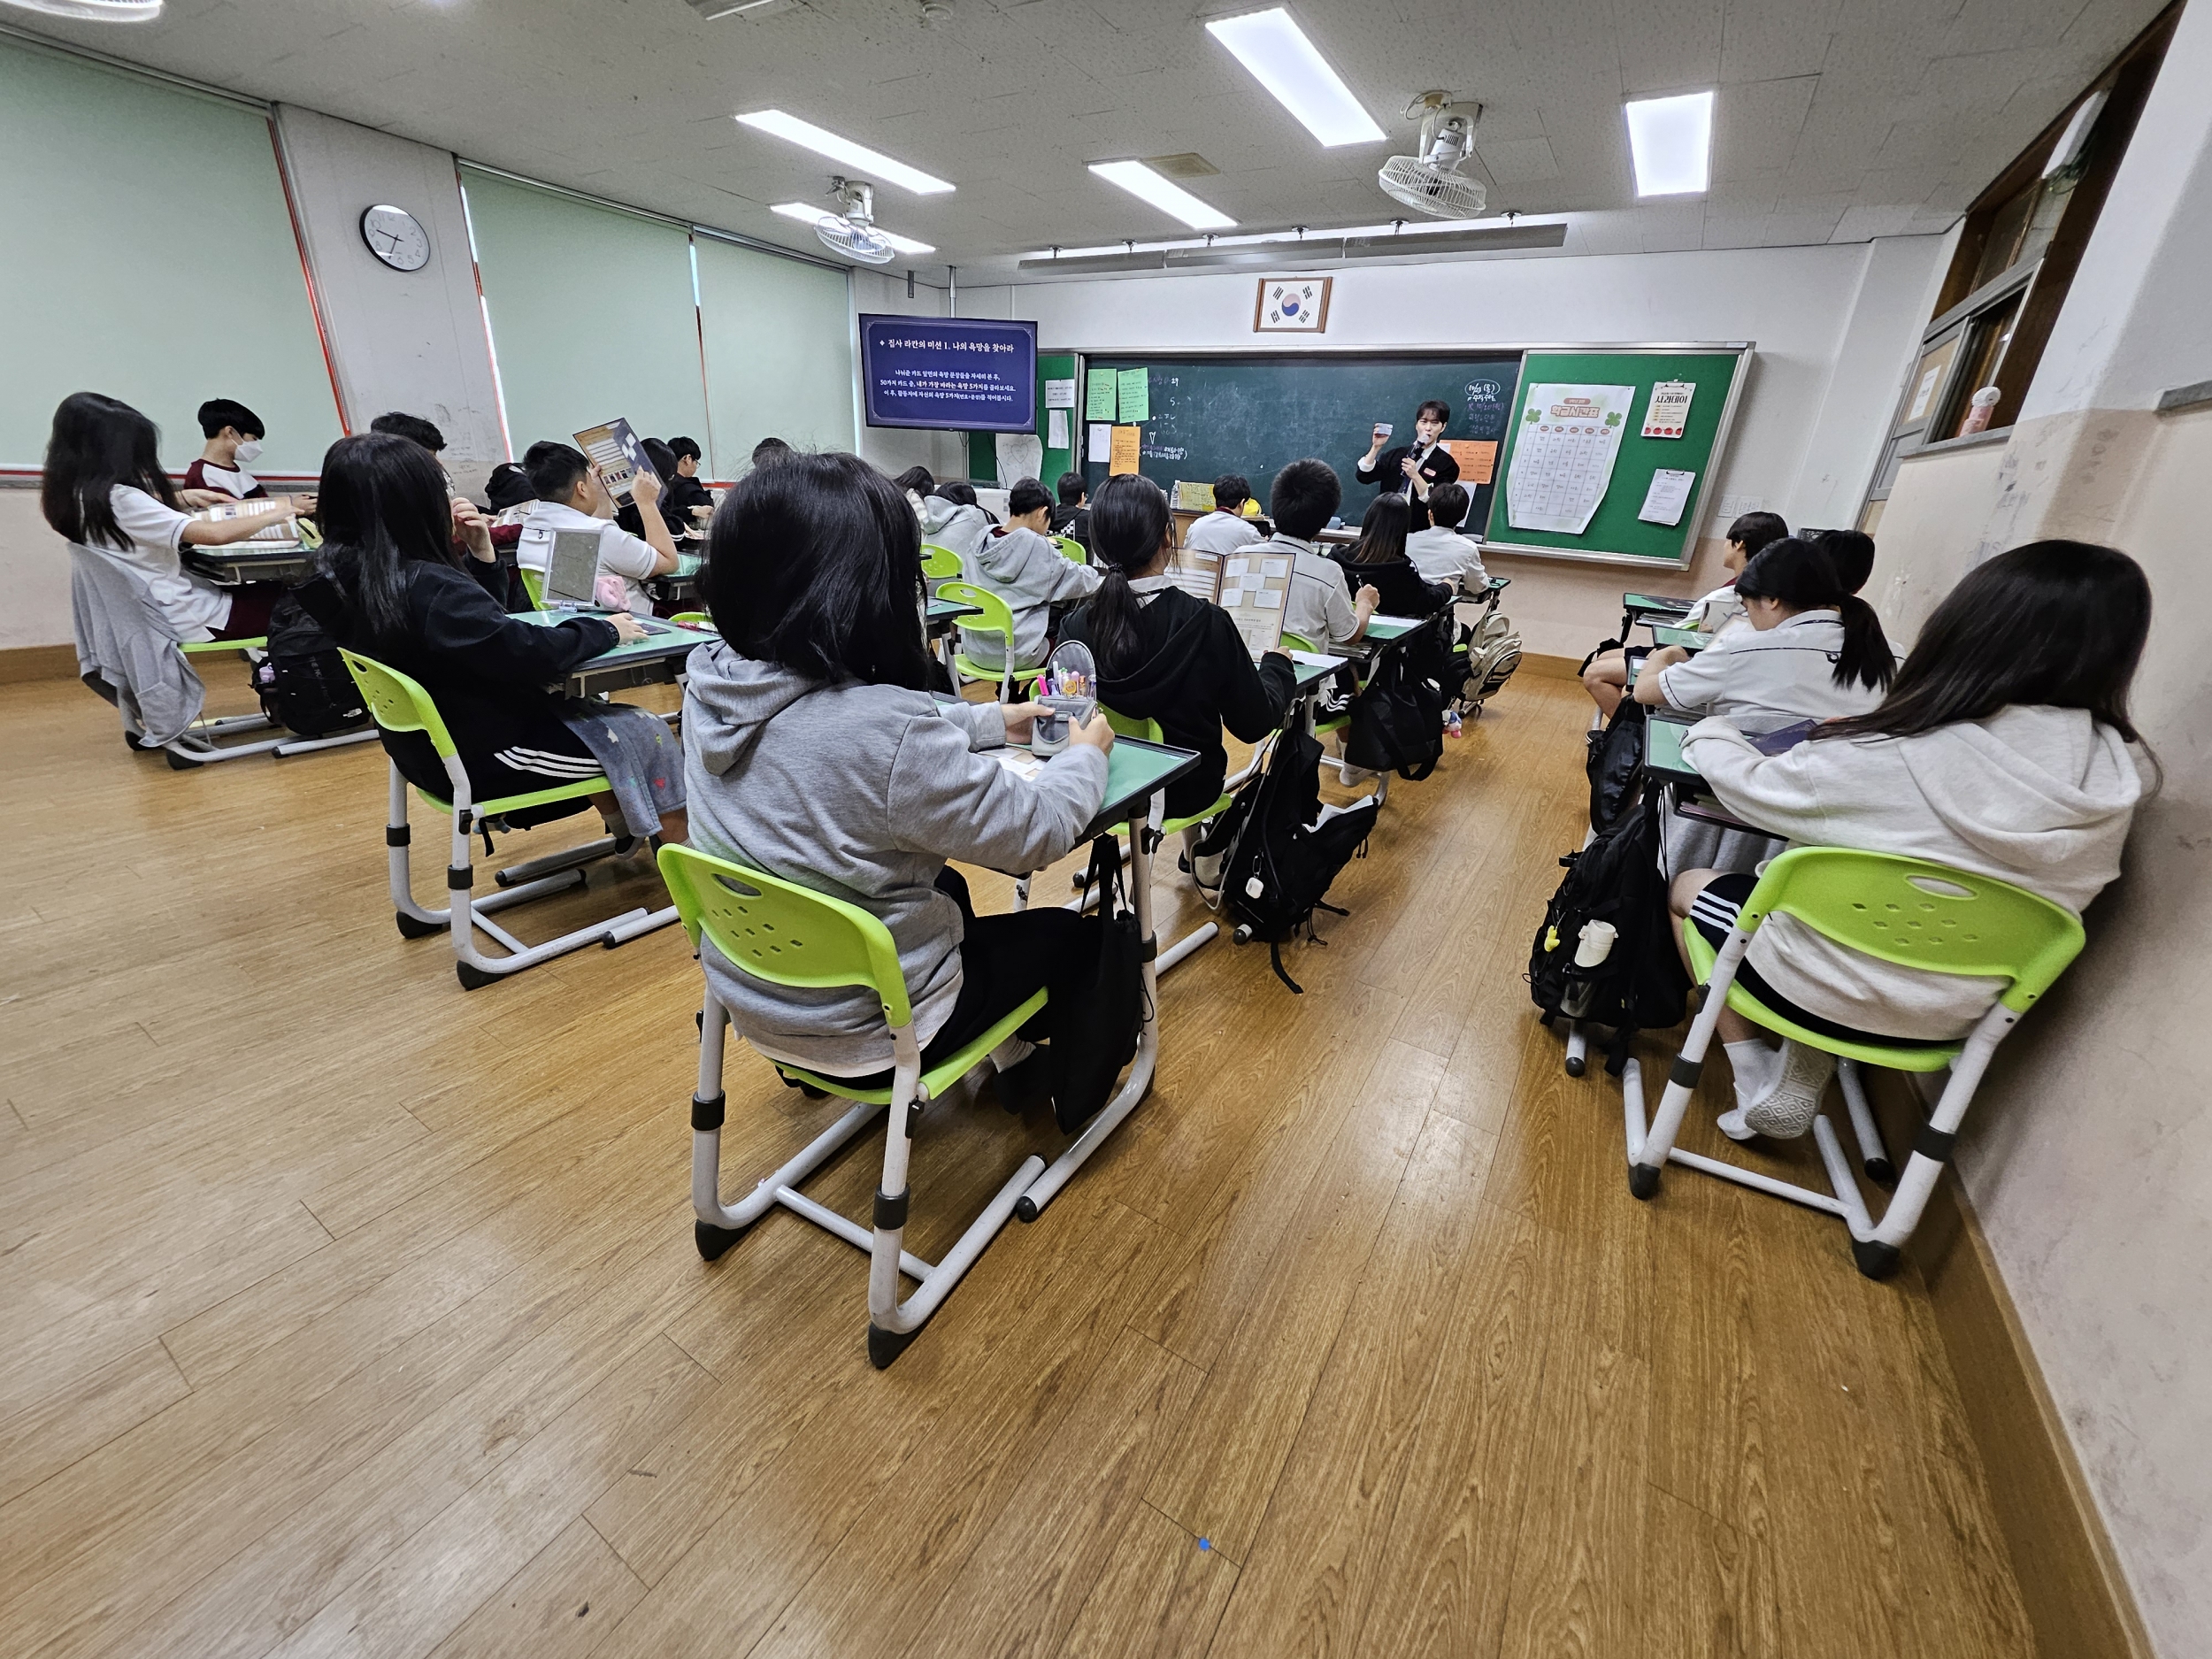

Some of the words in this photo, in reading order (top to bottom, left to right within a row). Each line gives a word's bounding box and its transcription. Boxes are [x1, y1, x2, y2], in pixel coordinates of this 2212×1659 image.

[417, 239, 422, 248] 3
[408, 255, 414, 264] 5
[888, 339, 902, 349] 집사
[927, 340, 942, 350] 미션
[944, 342, 951, 350] 1.
[952, 342, 967, 351] 나의
[969, 342, 991, 352] 욕망을
[992, 342, 1015, 353] 찾아라
[1550, 405, 1600, 418] 학급시간표
